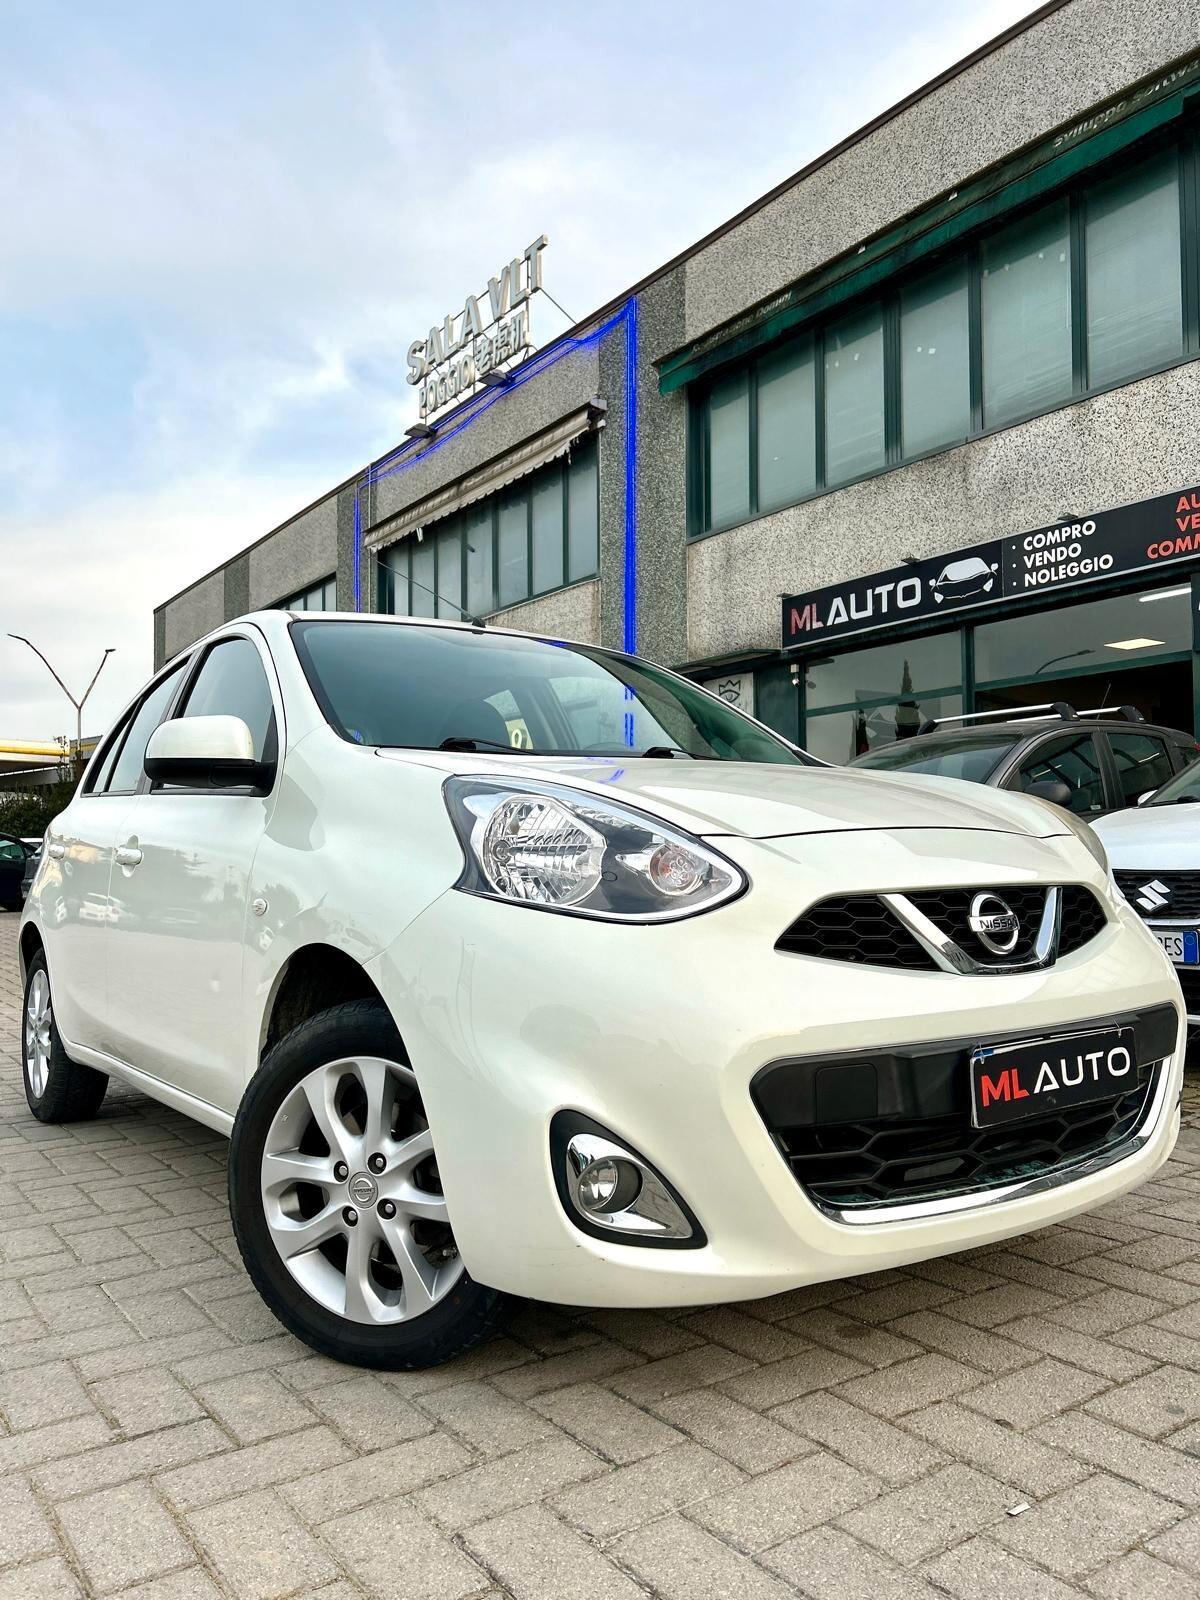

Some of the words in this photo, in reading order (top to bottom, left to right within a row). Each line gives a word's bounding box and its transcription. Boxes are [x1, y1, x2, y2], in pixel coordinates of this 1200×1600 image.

[406, 294, 483, 386] SALA
[487, 234, 548, 322] VLT
[419, 354, 476, 419] POGGIO
[1023, 520, 1096, 552] COMPRO
[1023, 542, 1082, 570] VENDO
[1024, 554, 1114, 588] NOLEGGIO
[790, 602, 824, 635] ML
[827, 577, 922, 626] AUTO
[981, 1068, 1030, 1107] ML
[1033, 1046, 1131, 1094] AUTO
